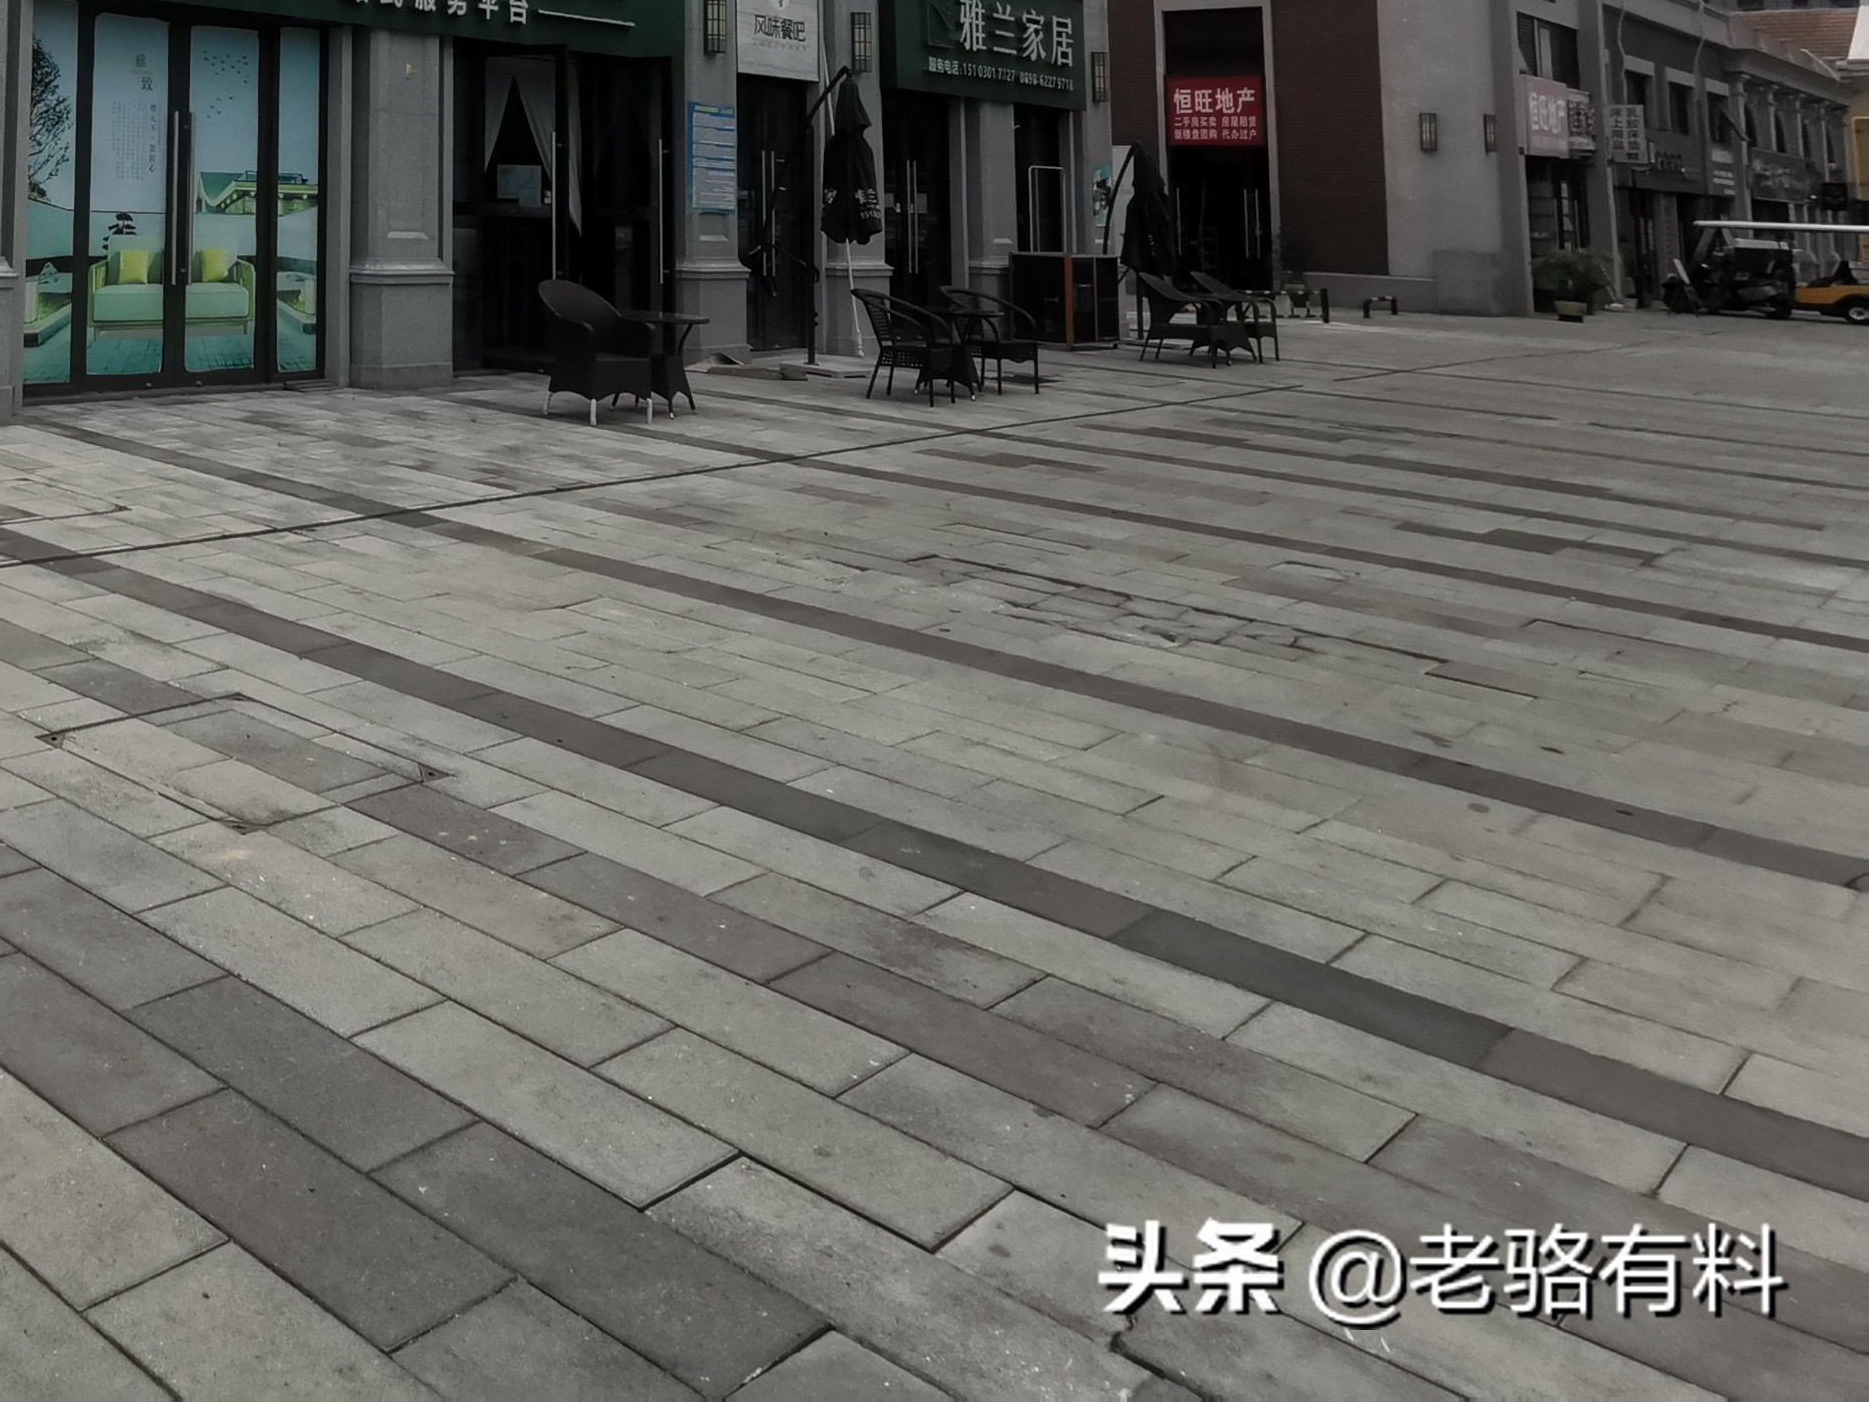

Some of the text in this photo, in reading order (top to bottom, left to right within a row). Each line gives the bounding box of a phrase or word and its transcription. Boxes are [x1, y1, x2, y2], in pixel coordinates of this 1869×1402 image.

[754, 14, 806, 42] 风味餐吧
[1173, 86, 1256, 115] 恒旺地产
[1174, 115, 1257, 127] 二手房买卖 房屋租赁
[1174, 128, 1258, 140] 新楼盘团购 代办过户
